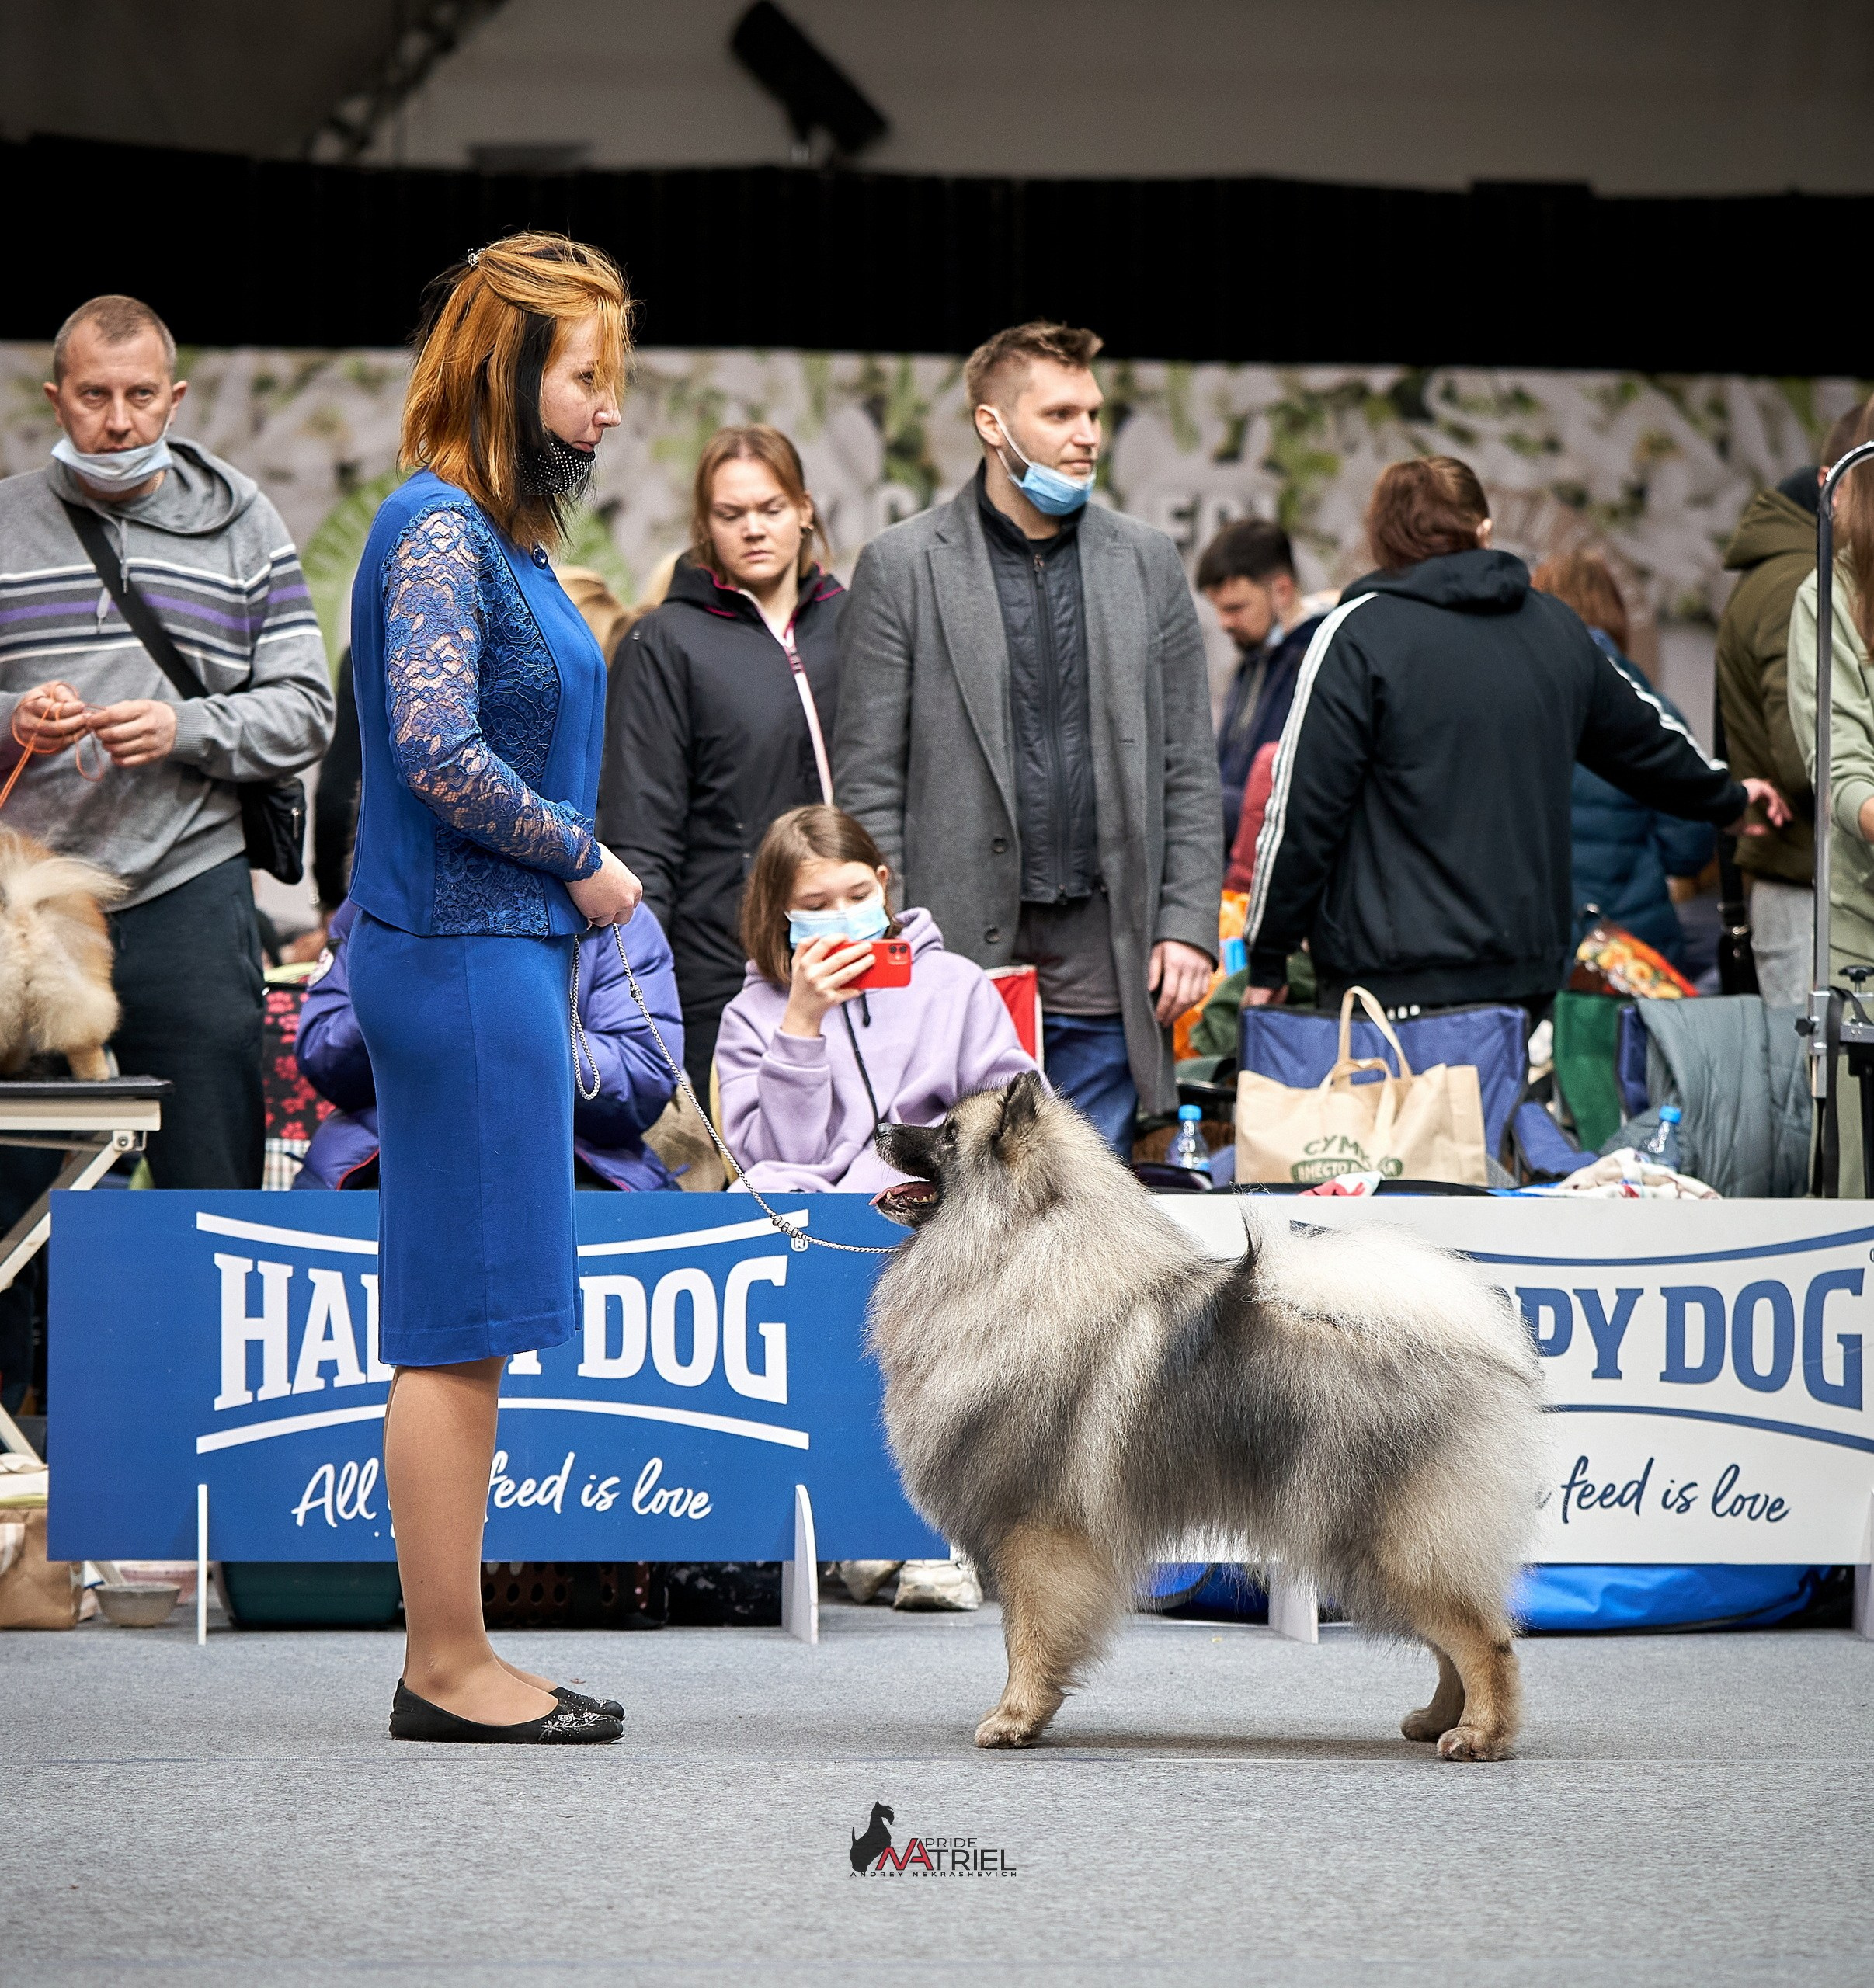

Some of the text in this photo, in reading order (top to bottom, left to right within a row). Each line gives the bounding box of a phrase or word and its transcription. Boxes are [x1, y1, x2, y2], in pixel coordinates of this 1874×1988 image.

[577, 1254, 788, 1405] DOG
[1660, 1267, 1865, 1412] DOG
[290, 1457, 380, 1528] All
[485, 1449, 575, 1524] feed
[580, 1474, 621, 1513] is
[631, 1457, 713, 1520] love
[1561, 1455, 1655, 1524] feed
[1661, 1479, 1699, 1515] is
[1711, 1463, 1791, 1524] love
